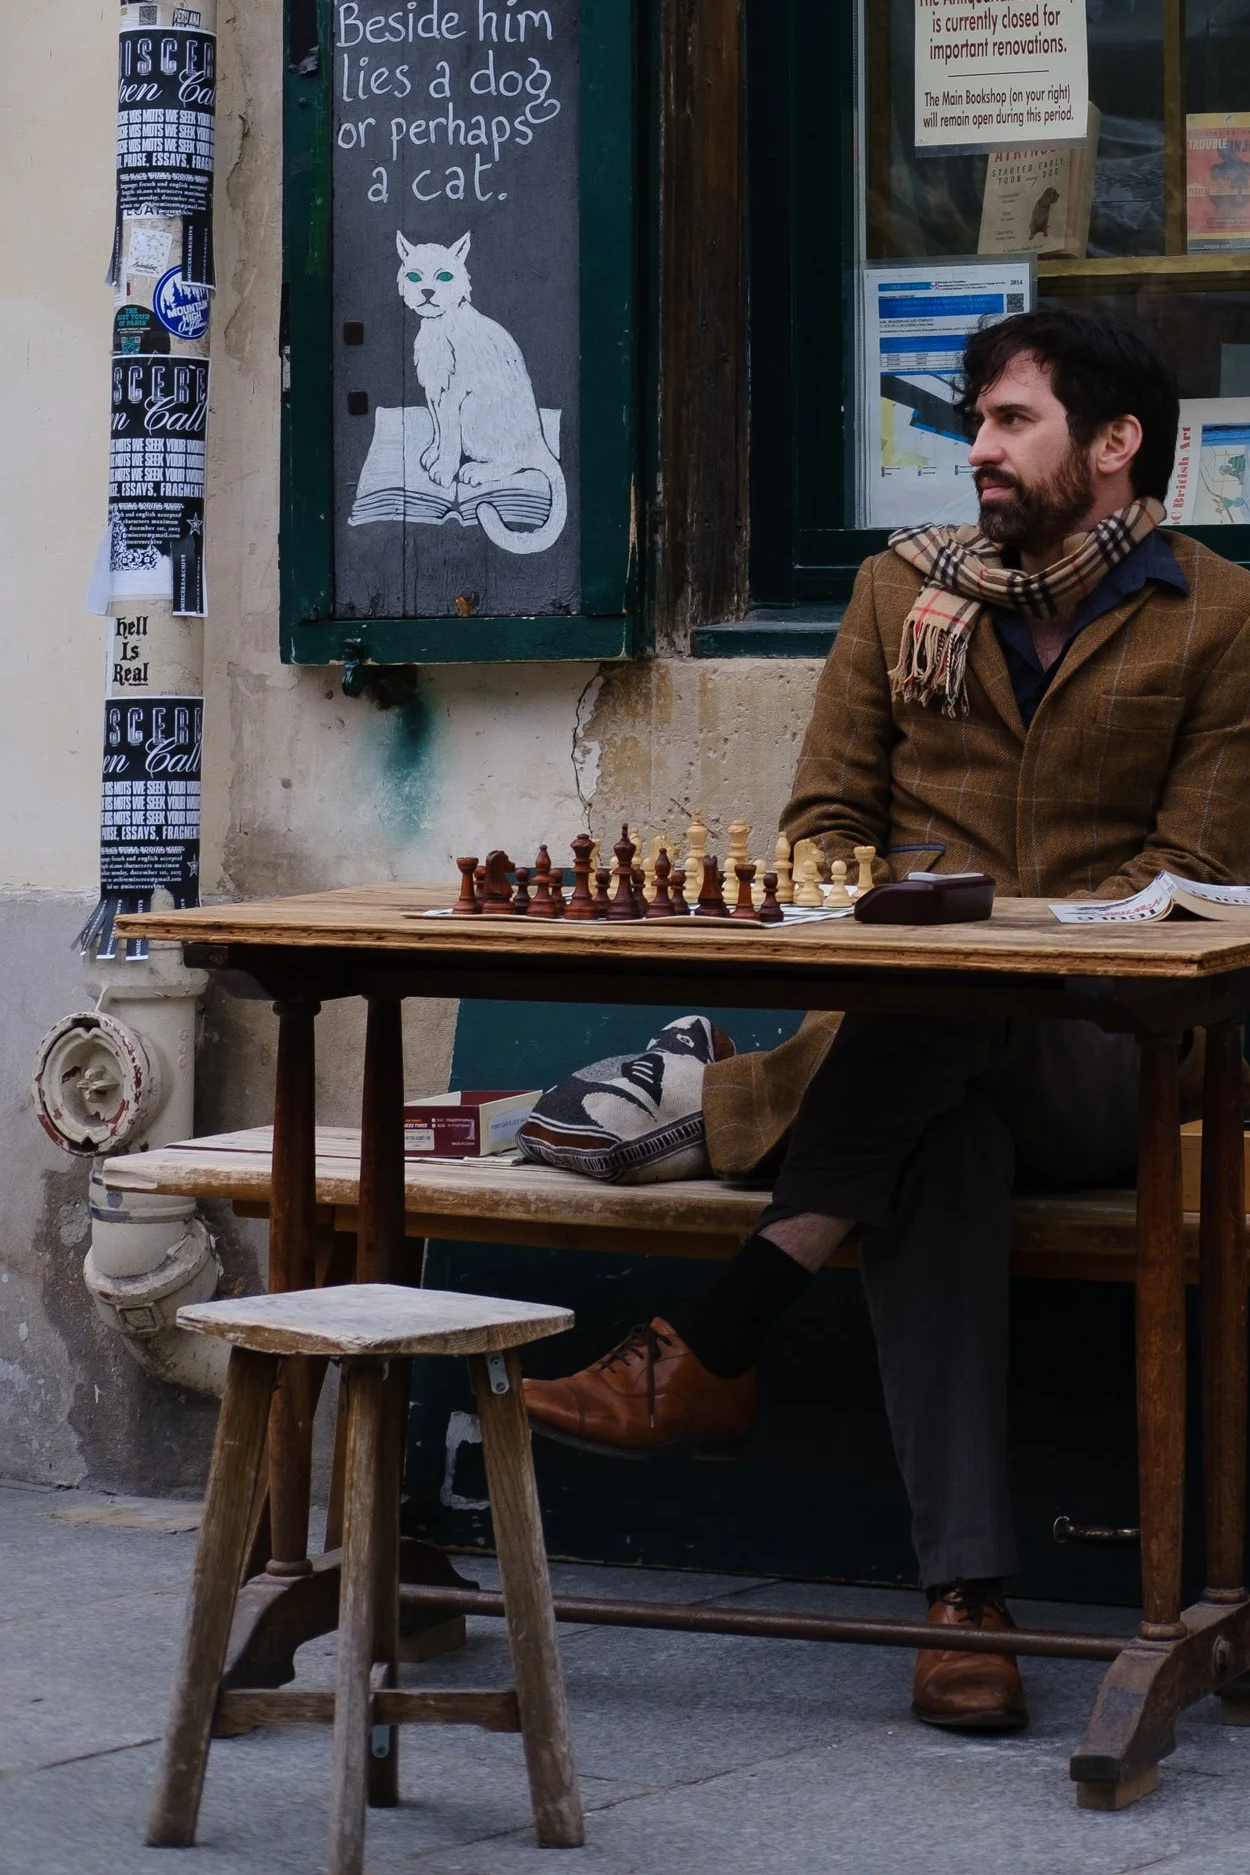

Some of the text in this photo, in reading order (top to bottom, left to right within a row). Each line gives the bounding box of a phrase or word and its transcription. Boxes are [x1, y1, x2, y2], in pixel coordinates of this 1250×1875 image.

[932, 3, 1061, 35] is currently closed for
[929, 32, 1067, 65] important renovations.
[342, 50, 561, 124] lies a dog
[337, 102, 534, 161] or perhaps
[1188, 136, 1228, 150] TROUBLE
[367, 153, 508, 204] a cat.
[1173, 426, 1191, 509] British Art
[115, 615, 149, 639] Hell
[120, 641, 139, 662] Is
[112, 662, 149, 686] Real
